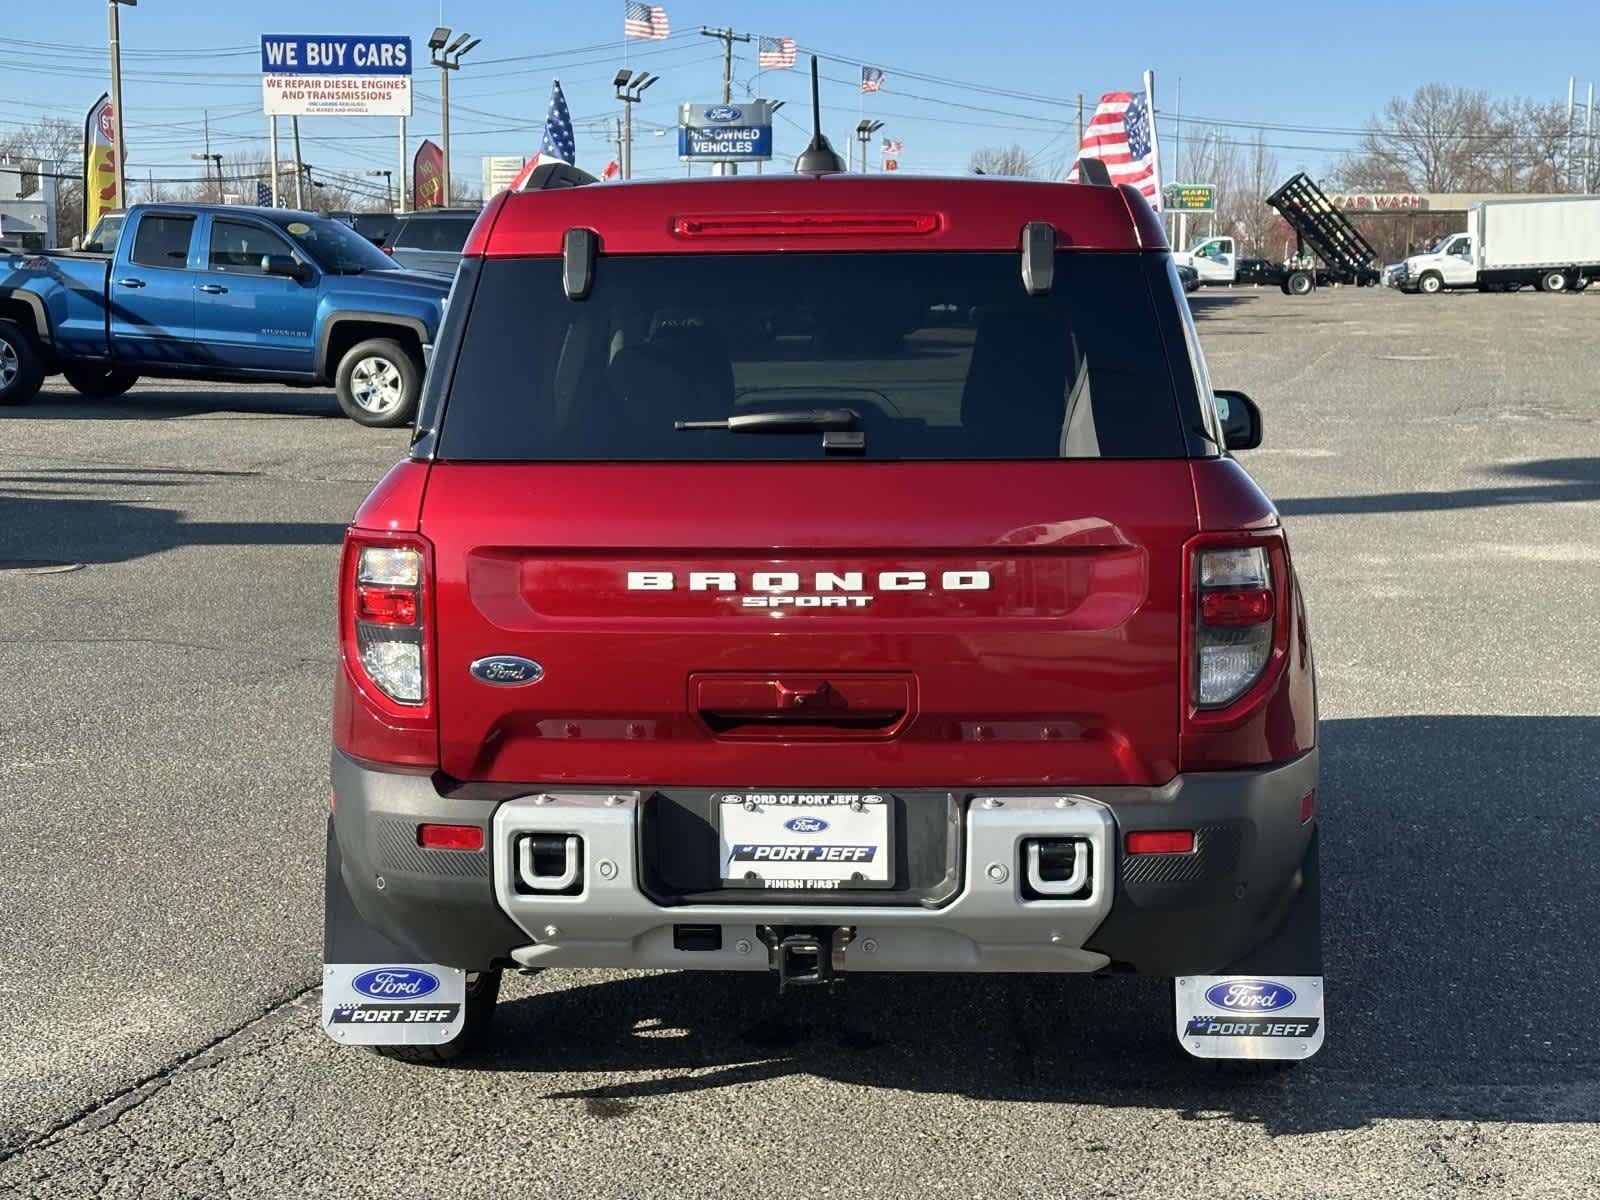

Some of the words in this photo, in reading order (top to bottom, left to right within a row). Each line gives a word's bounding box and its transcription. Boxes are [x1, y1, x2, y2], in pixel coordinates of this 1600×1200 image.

[265, 42, 297, 66] WE
[307, 42, 347, 66] BUY
[353, 43, 407, 67] CARS
[266, 79, 282, 88] WE
[285, 79, 321, 89] REPAIR
[324, 79, 359, 89] DIESEL
[361, 80, 407, 90] ENGINES
[281, 91, 305, 100] AND
[308, 91, 392, 100] TRANSMISSIONS
[710, 108, 734, 119] Ford
[687, 128, 760, 140] PRE-OWNED
[693, 142, 753, 153] VEHICLES
[1333, 196, 1367, 209] CAR
[1374, 196, 1421, 209] WASH
[627, 571, 991, 592] BRONCO
[741, 595, 874, 608] SPORT
[486, 662, 526, 680] Ford
[745, 795, 777, 804] FORD
[780, 795, 795, 804] OF
[798, 795, 828, 804] PORT
[831, 795, 859, 804] JEFF
[792, 818, 821, 832] Ford
[754, 846, 815, 860] PORT
[815, 847, 870, 861] JEFF
[764, 879, 803, 889] FINISH
[806, 879, 841, 889] FIRST
[369, 972, 422, 994] Ford
[1223, 984, 1277, 1007] Ford
[351, 1010, 403, 1022] PORT
[404, 1010, 451, 1022] JEFF
[1207, 1023, 1260, 1035] PORT
[1262, 1023, 1310, 1036] JEFF
